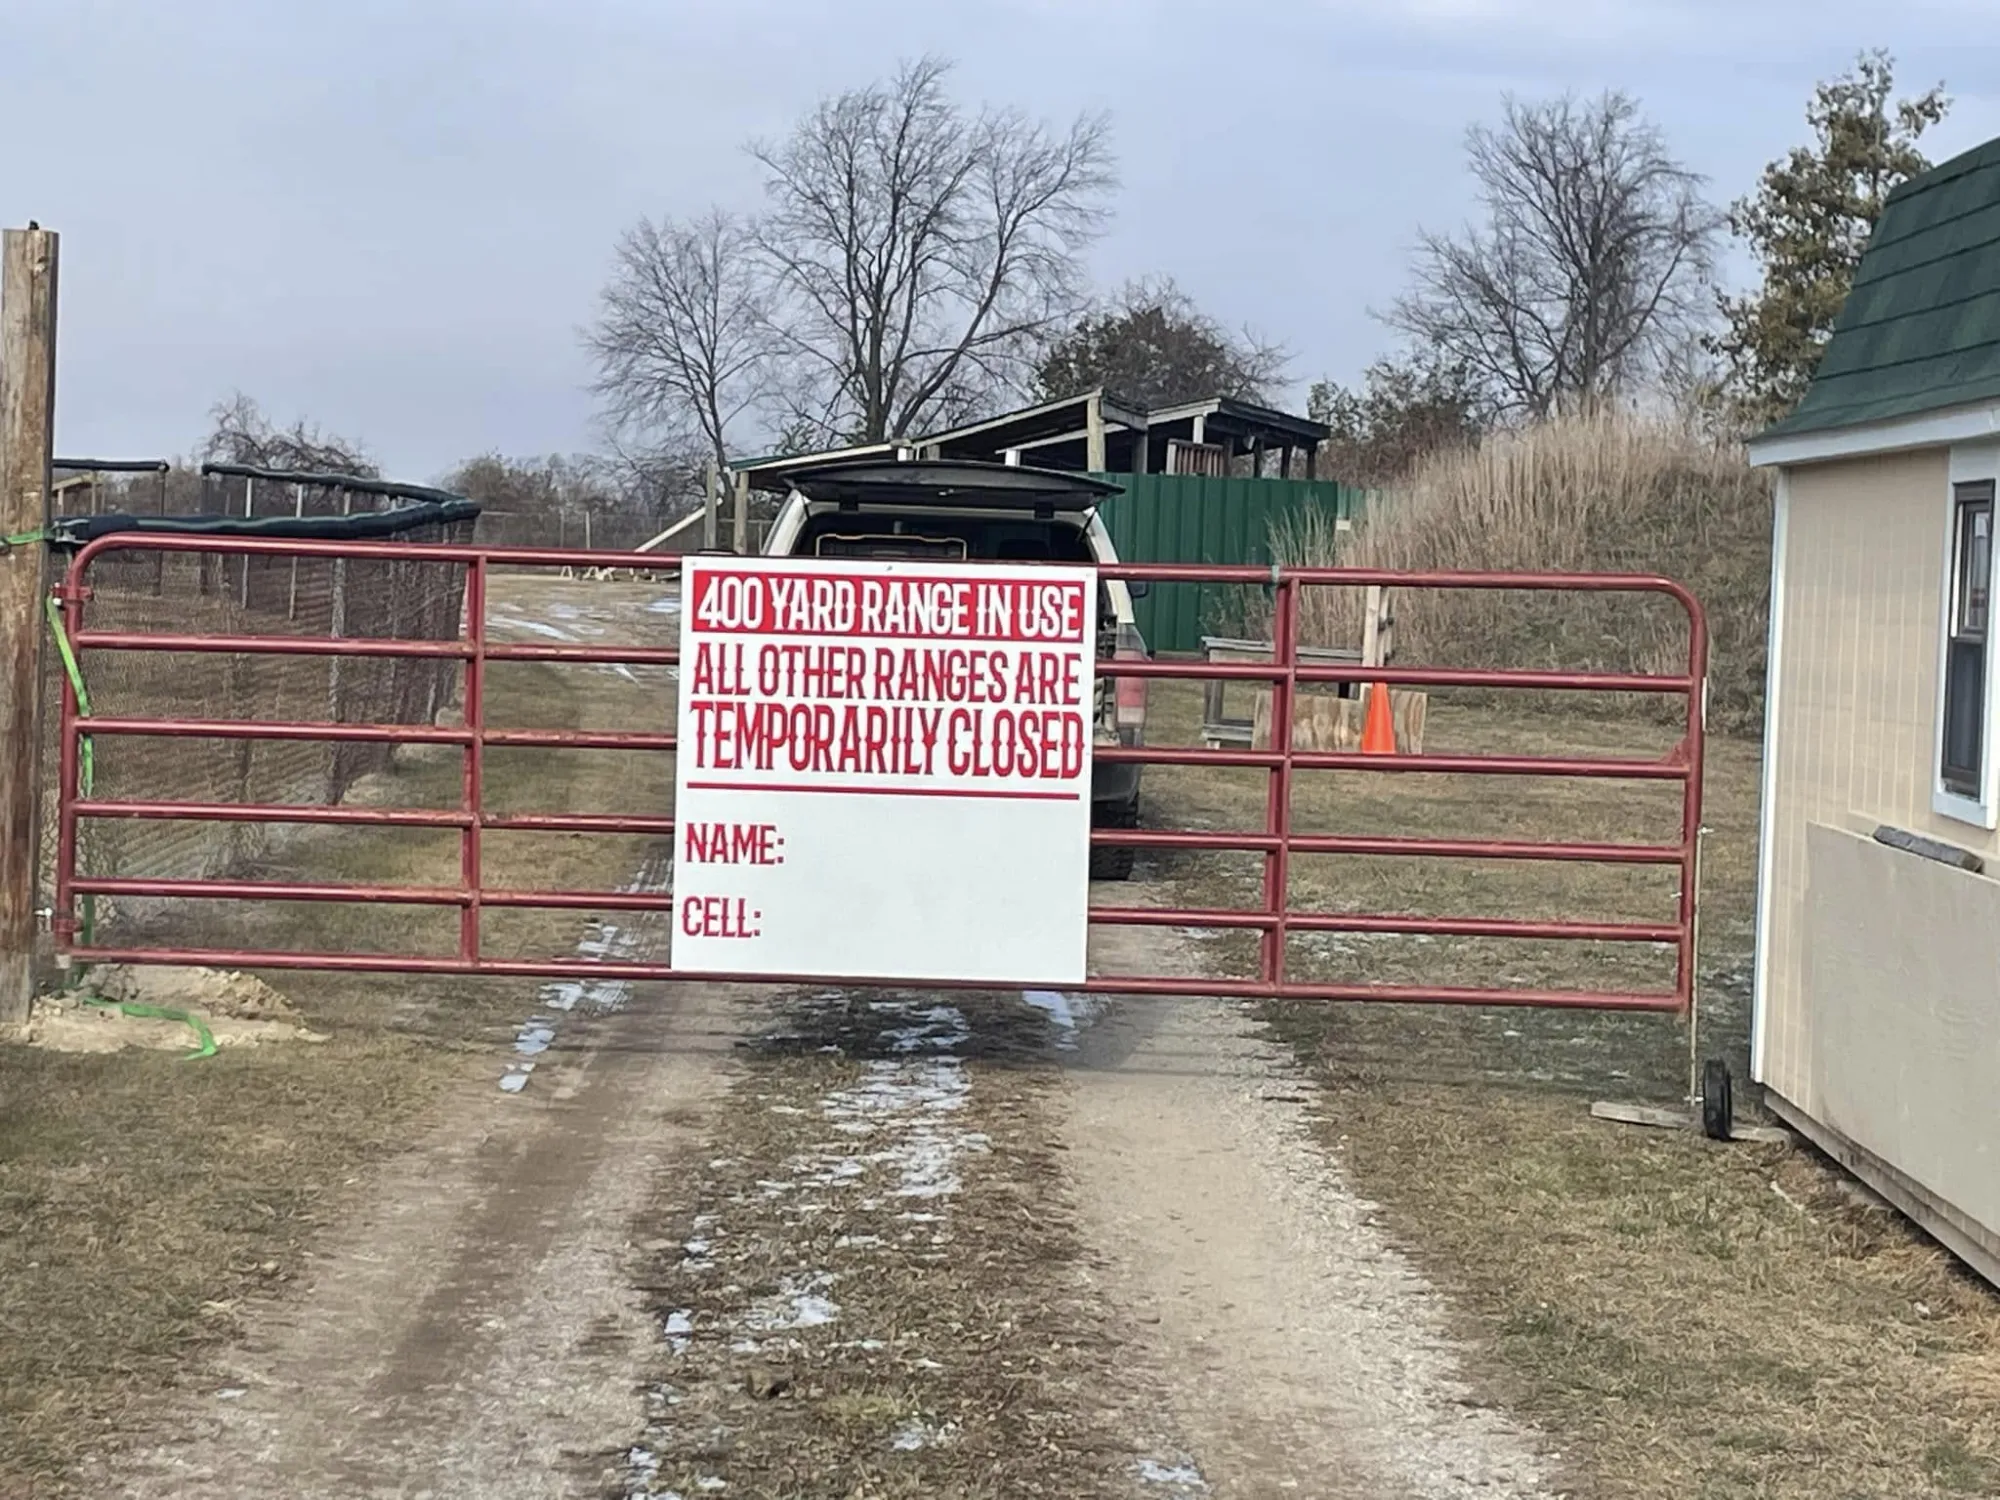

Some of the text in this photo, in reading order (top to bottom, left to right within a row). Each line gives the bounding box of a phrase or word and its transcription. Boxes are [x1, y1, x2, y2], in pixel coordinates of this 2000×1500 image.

[698, 575, 1081, 639] 400 YARD RANGE IN USE
[691, 642, 1081, 705] ALL OTHER RANGES ARE
[690, 701, 1084, 780] TEMPORARILY CLOSED
[685, 822, 785, 865] NAME:
[682, 896, 761, 938] CELL:
